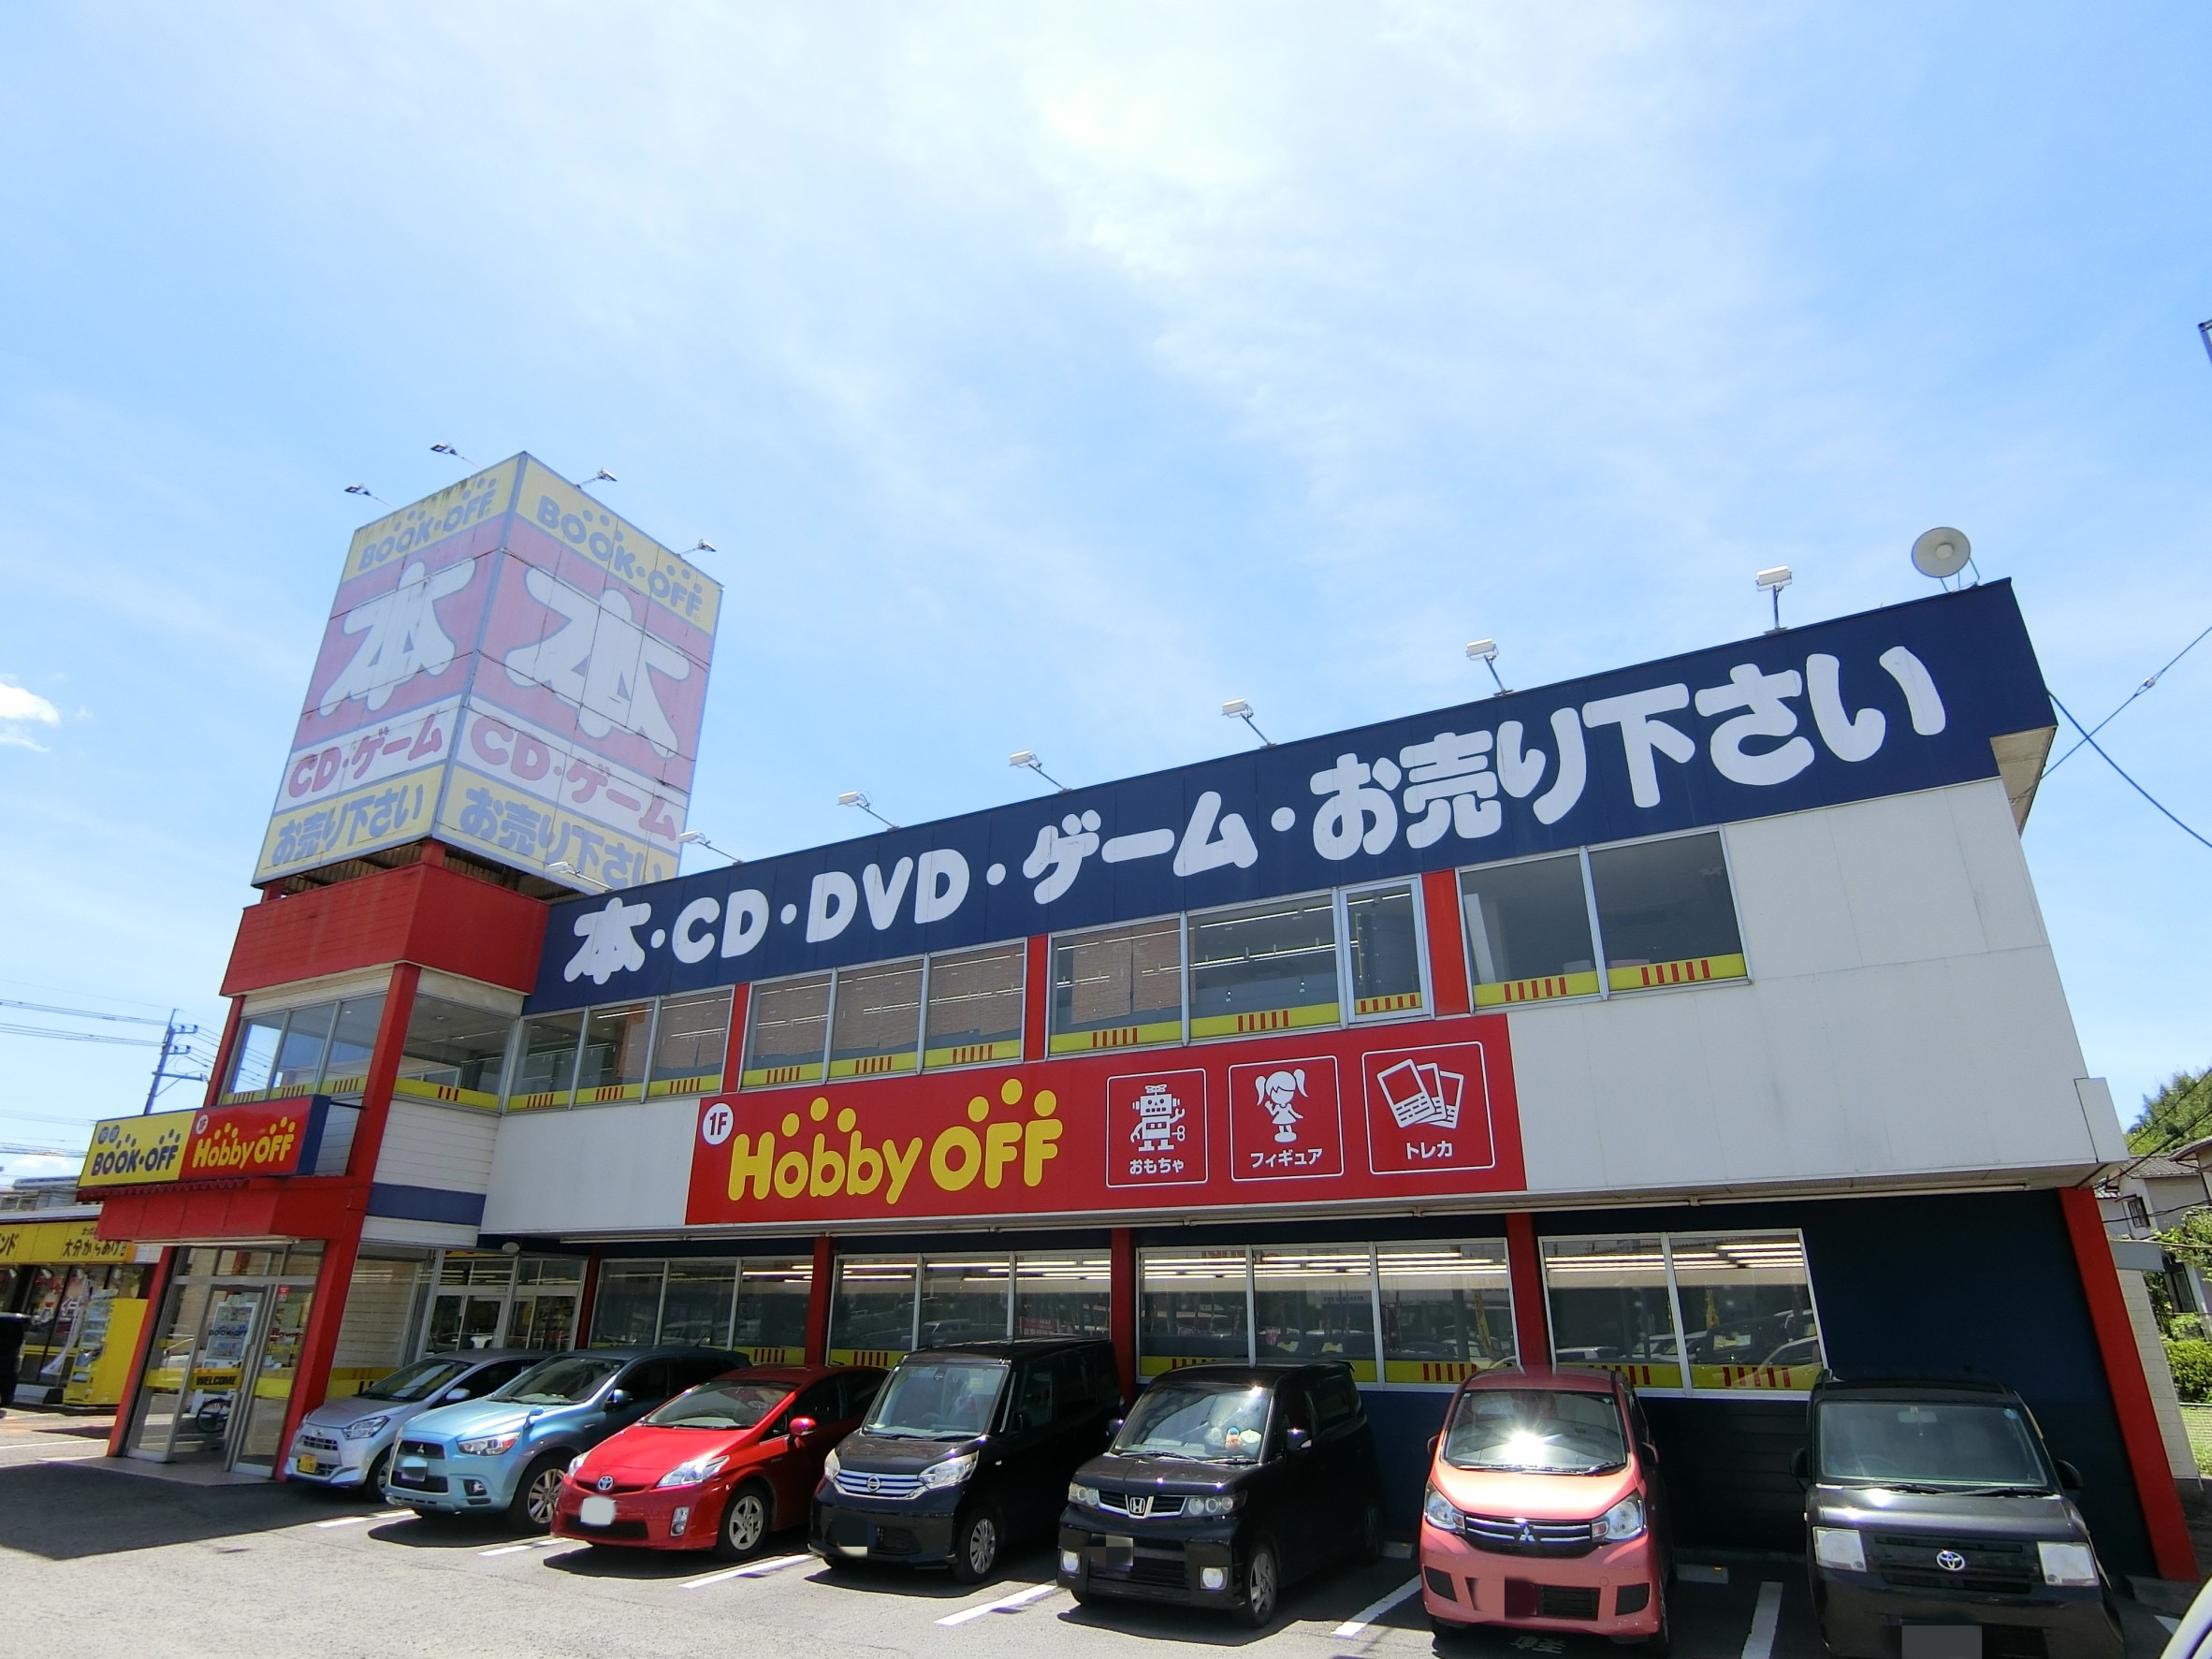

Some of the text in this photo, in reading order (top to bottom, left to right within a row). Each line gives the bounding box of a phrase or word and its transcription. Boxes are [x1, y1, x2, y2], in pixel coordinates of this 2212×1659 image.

[319, 559, 475, 717] 本
[505, 566, 691, 758] 本
[272, 784, 424, 866] お売り下さい
[710, 1112, 728, 1135] 1F
[192, 1134, 295, 1170] Hobby OFF
[728, 1118, 1063, 1204] Hobby OFF
[1250, 1148, 1323, 1168] フィギュア
[1405, 1141, 1452, 1160] トレカ
[1129, 1157, 1185, 1175] おもちゃ
[196, 1375, 237, 1386] WELCOME
